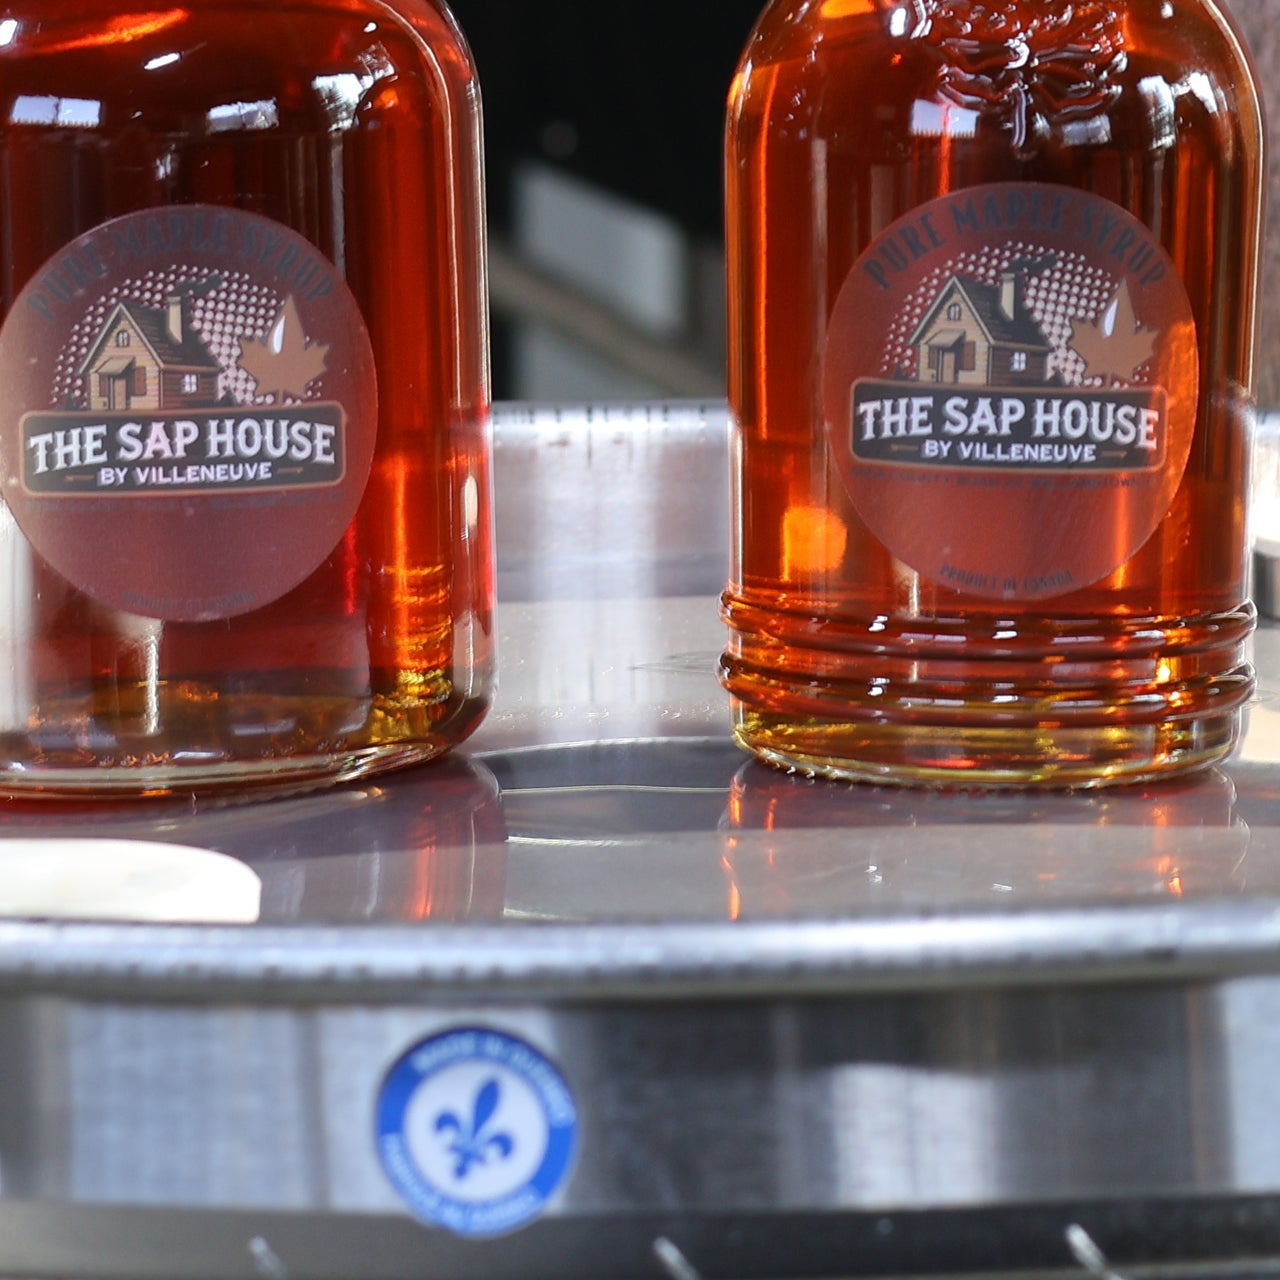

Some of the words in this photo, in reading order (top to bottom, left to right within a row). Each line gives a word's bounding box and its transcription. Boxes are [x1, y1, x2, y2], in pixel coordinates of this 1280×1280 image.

[863, 215, 947, 290] PURE
[948, 190, 1067, 235] MAPLE
[1075, 201, 1167, 286] SYRUP
[26, 239, 110, 322] PURE
[112, 215, 230, 263] MAPLE
[233, 220, 334, 302] SYRUP
[28, 425, 108, 474] THE
[118, 420, 199, 462] SAP
[208, 418, 336, 464] HOUSE
[857, 396, 933, 441] THE
[942, 397, 1025, 437] SAP
[1033, 398, 1160, 450] HOUSE
[98, 466, 128, 486] BY
[137, 462, 272, 486] VILLENEUVE
[924, 440, 951, 458] BY
[960, 441, 1096, 462] VILLENEUVE
